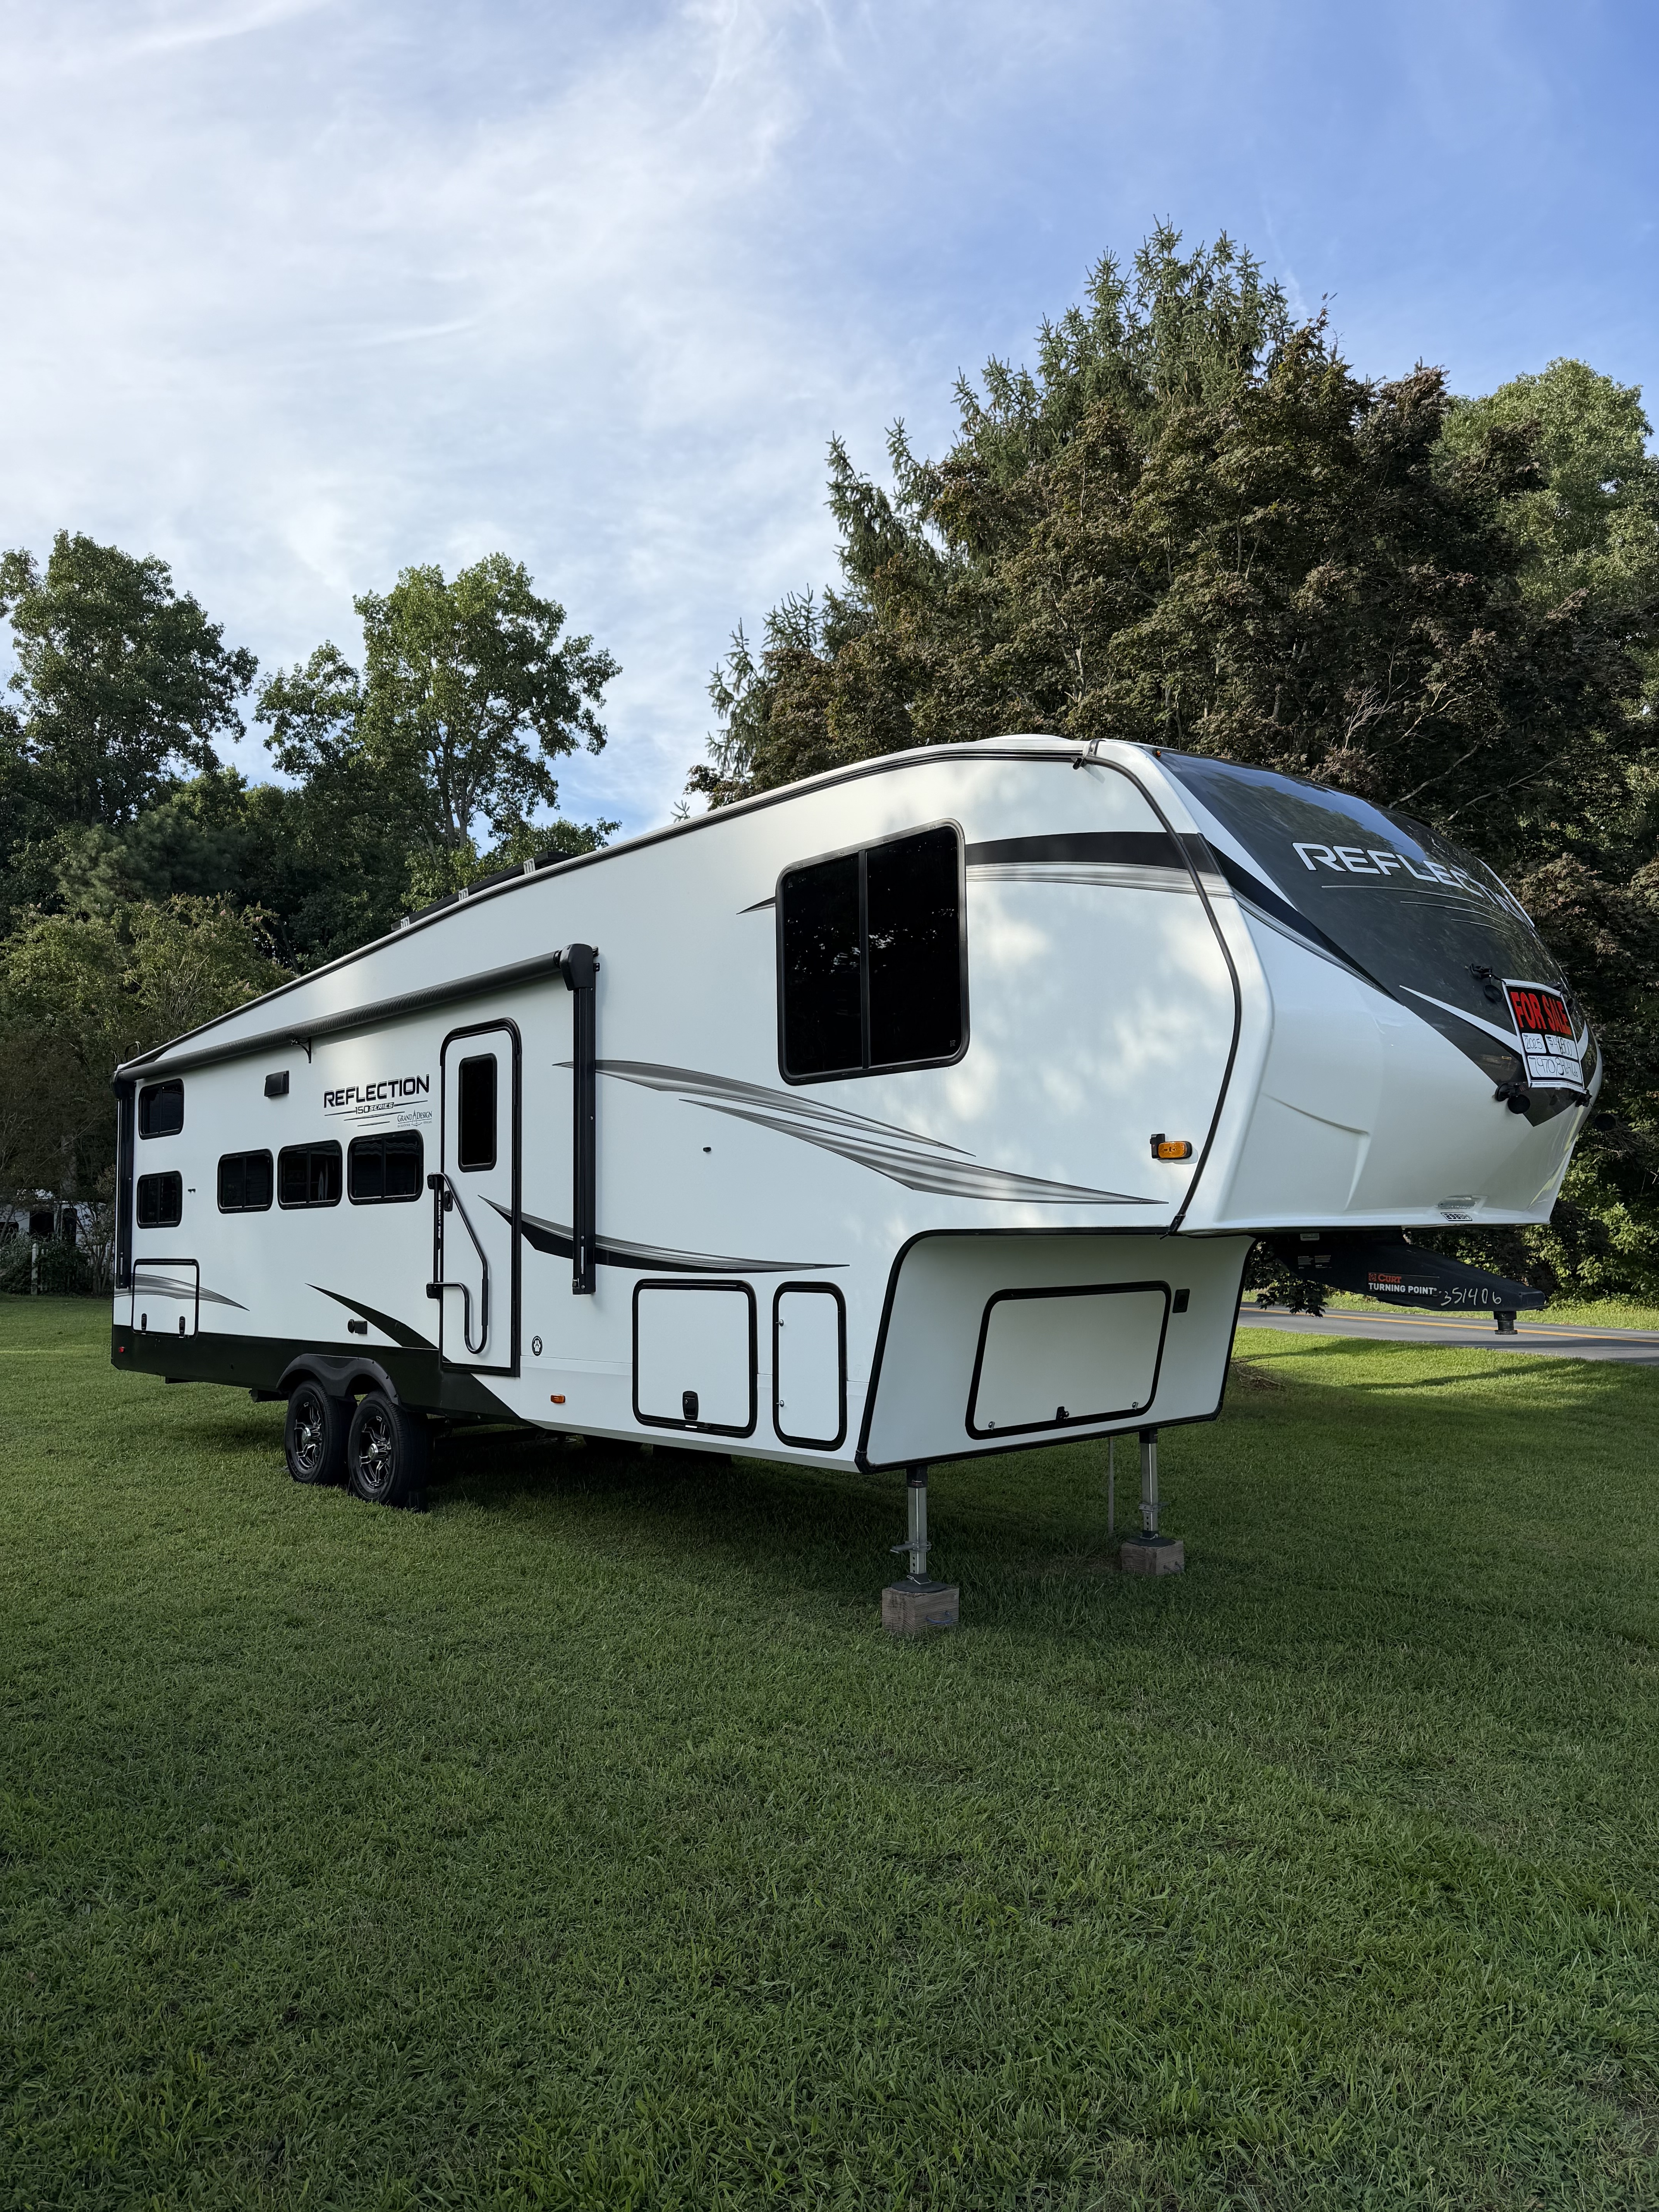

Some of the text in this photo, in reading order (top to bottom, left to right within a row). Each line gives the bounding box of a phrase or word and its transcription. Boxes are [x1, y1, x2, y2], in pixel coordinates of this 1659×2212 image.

[1293, 843, 1528, 926] REFLECTIO
[1510, 992, 1572, 1036] FOR SALE
[1525, 1037, 1542, 1049] 2025
[324, 1074, 429, 1108] REFLECTION
[355, 1102, 394, 1115] 150 SERIES
[397, 1111, 433, 1122] GRAND DESIGN
[1377, 1273, 1401, 1283] CURT
[1369, 1282, 1405, 1292] TURNING
[1441, 1287, 1501, 1306] 351406
